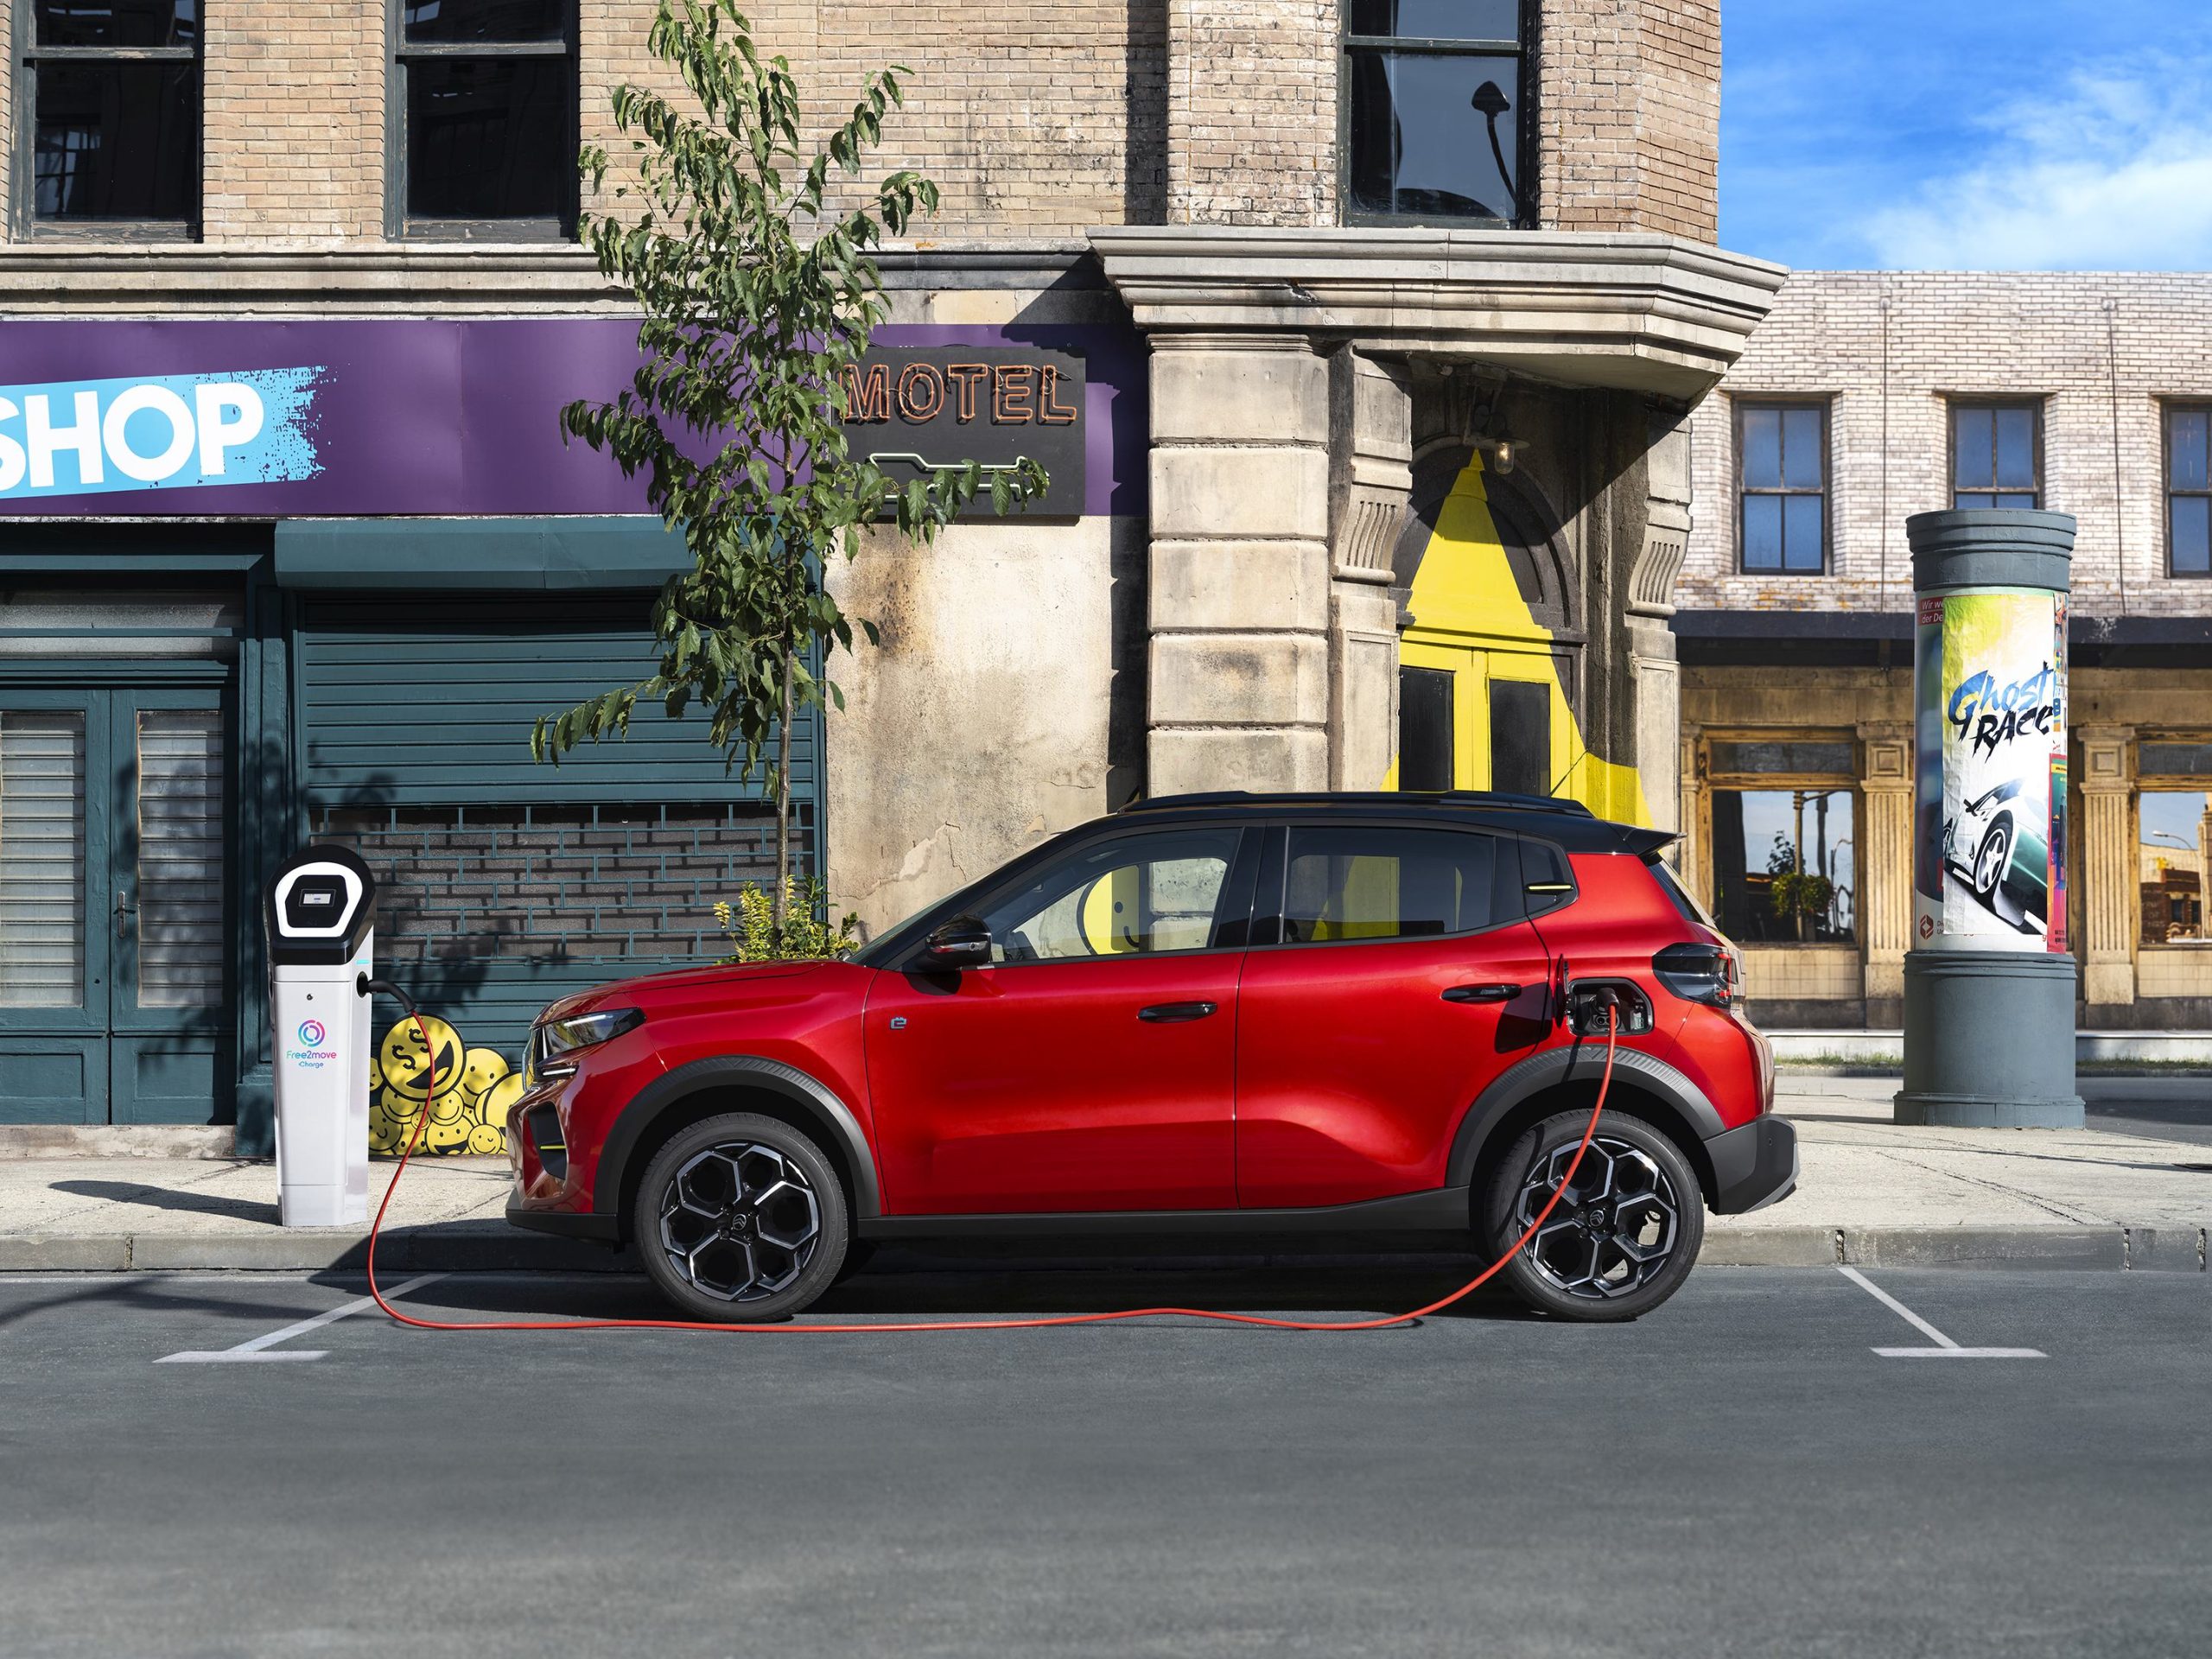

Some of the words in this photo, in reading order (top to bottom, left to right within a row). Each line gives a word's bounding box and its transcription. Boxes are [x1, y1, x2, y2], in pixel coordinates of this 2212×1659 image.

[839, 363, 1077, 421] MOTEL
[1948, 660, 2054, 743] Ghost
[286, 1050, 337, 1059] Free2move
